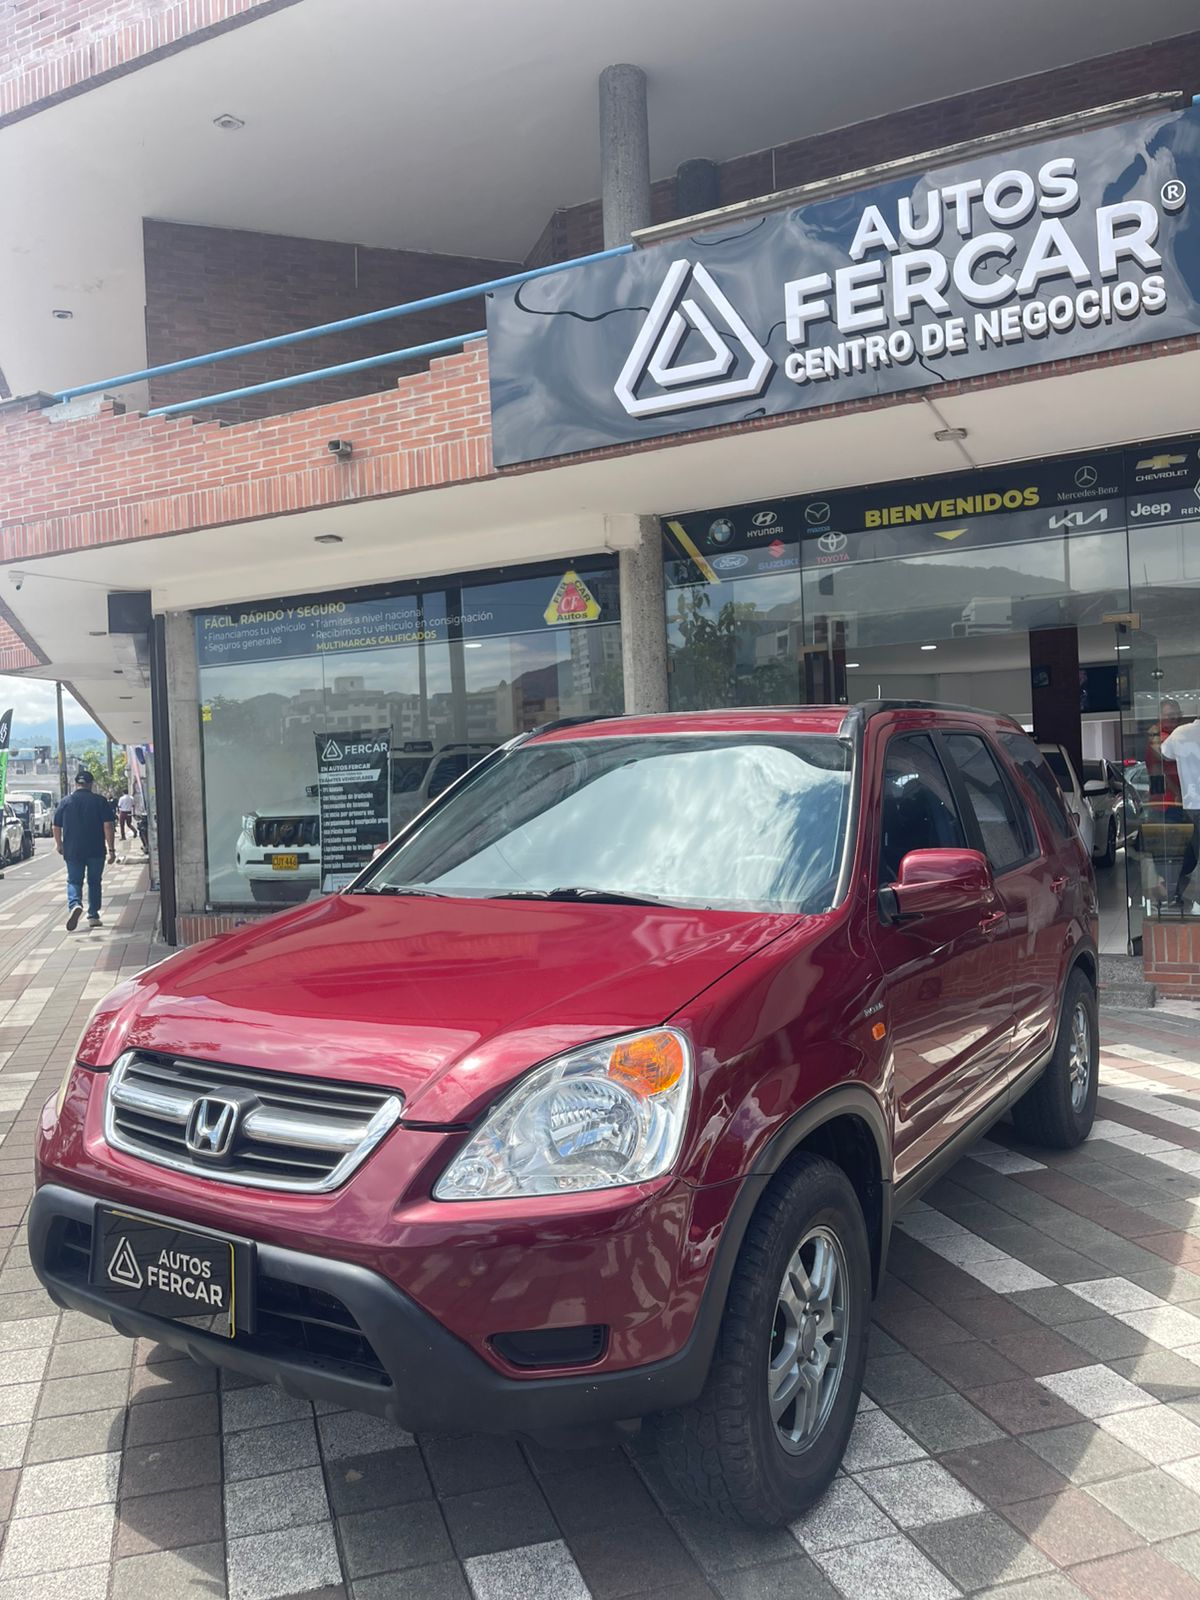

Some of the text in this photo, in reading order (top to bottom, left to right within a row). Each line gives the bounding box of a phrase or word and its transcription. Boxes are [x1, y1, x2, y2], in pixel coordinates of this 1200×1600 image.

[849, 158, 1080, 261] AUTOS
[784, 200, 1163, 345] FERCAR
[784, 275, 1167, 383] CENTRO DE NEGOCIOS
[1136, 469, 1189, 482] CHEVROLET
[1057, 486, 1119, 501] Mercedes-Benz
[865, 487, 1040, 528] BIENVENIDOS
[1130, 503, 1171, 518] Jeep
[1049, 508, 1108, 529] KIA
[747, 526, 784, 538] HYUNDAI
[757, 558, 799, 570] SUZUKI
[816, 553, 850, 564] TOYOTA
[575, 580, 591, 602] CAR
[240, 608, 285, 625] RÁPIDO
[286, 609, 295, 618] Y
[297, 602, 346, 617] SEGURO
[354, 616, 360, 624] a
[362, 610, 383, 623] nivel
[385, 607, 424, 620] nacional
[558, 612, 588, 621] Autos
[207, 630, 258, 641] Financiamos
[260, 627, 270, 635] tu
[316, 626, 361, 639] Recibimos
[363, 625, 372, 634] tu
[415, 619, 427, 628] en
[429, 611, 493, 627] consignación
[209, 636, 282, 652] Seguros generales
[316, 630, 437, 650] MULTIMARCAS CALIFICADOS
[345, 742, 388, 755] FERCAR
[158, 1249, 211, 1279] AUTOS
[147, 1265, 223, 1307] FERCAR
